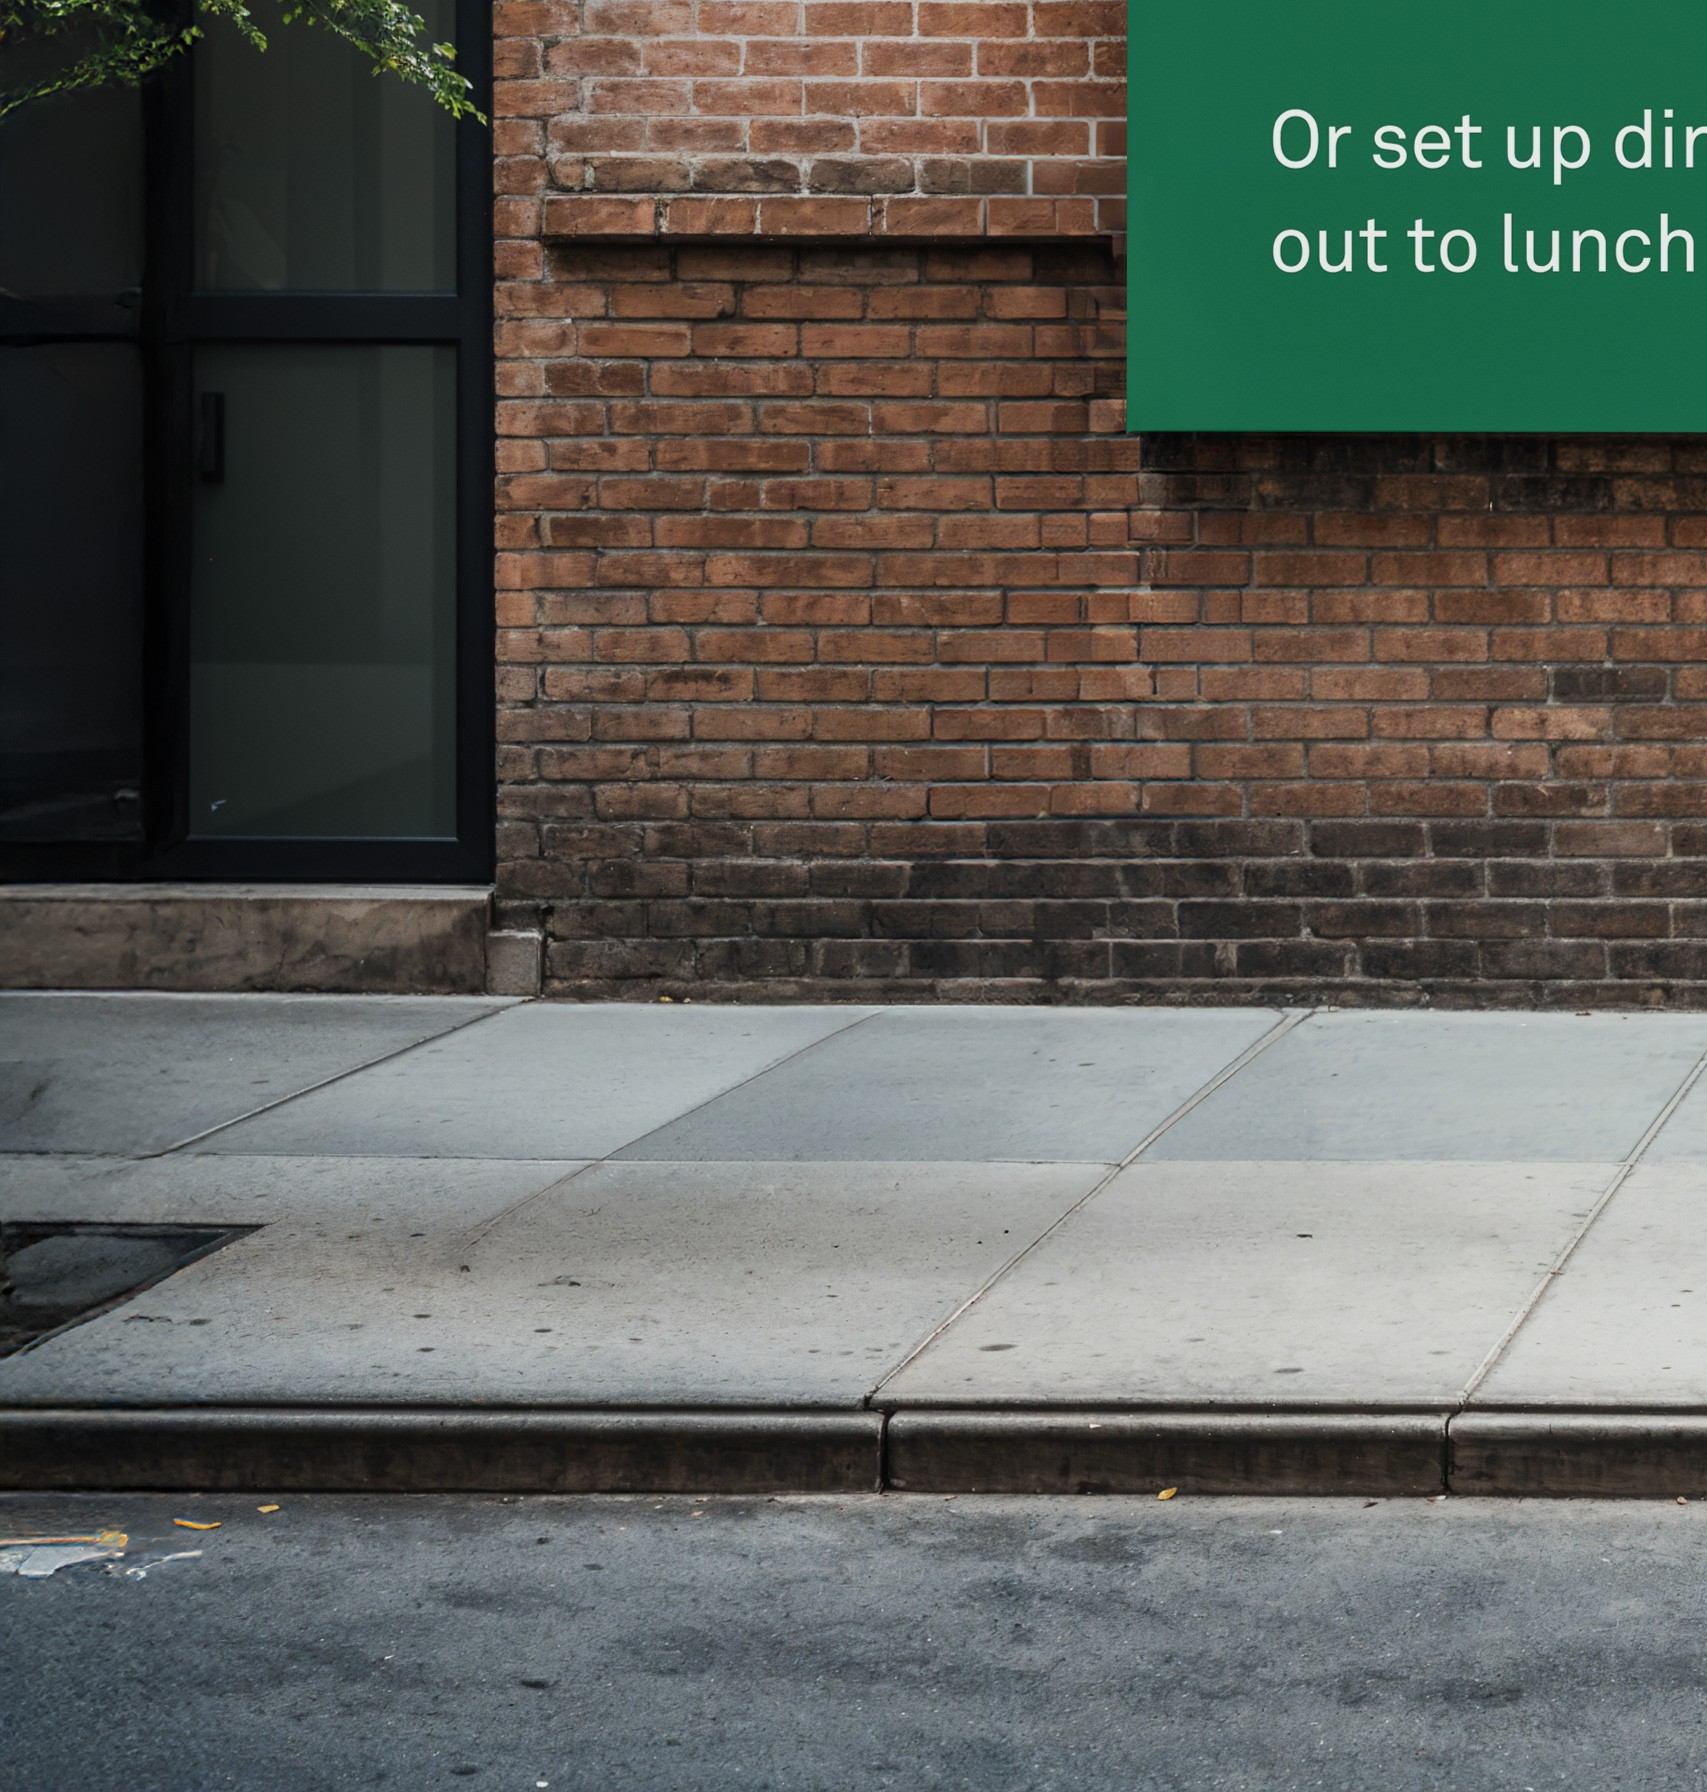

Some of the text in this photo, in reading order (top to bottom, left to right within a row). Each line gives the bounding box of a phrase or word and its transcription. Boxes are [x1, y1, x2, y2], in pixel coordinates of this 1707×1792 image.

[1273, 109, 1351, 169] Or
[1373, 115, 1482, 169] set
[1507, 125, 1590, 186] up
[1273, 219, 1387, 273] out
[1407, 219, 1477, 273] to
[1504, 213, 1694, 273] lunch
